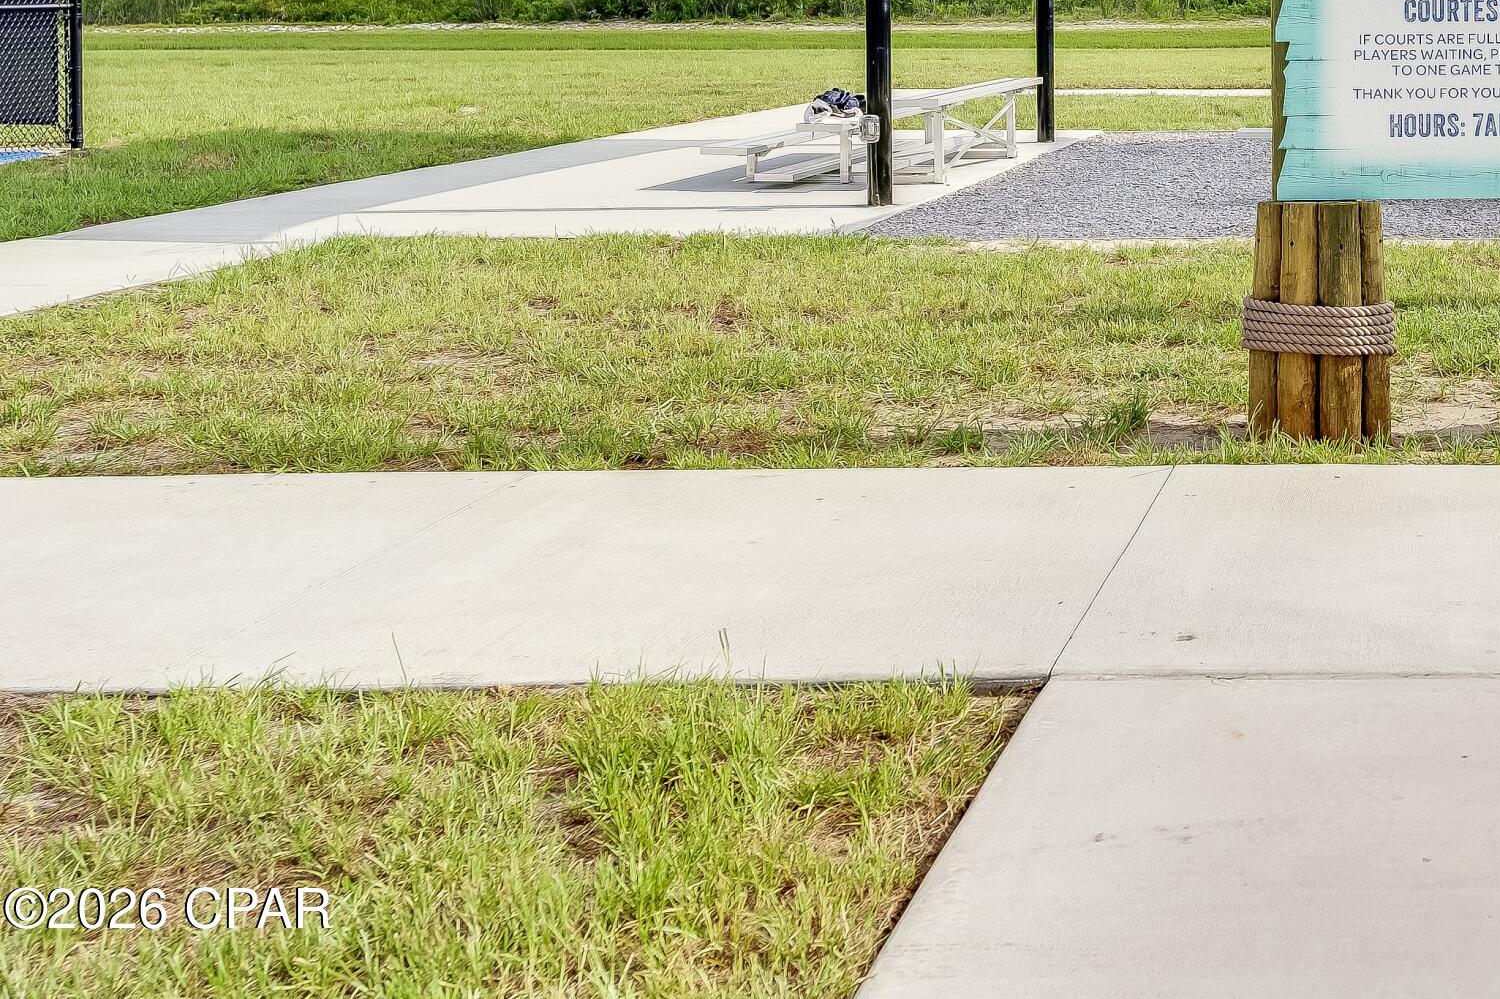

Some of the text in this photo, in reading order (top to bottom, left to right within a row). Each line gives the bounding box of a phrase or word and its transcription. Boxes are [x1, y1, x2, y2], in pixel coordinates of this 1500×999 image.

[1359, 33, 1372, 46] IF
[1374, 33, 1434, 46] COURTS
[1436, 32, 1465, 45] ARE
[1353, 48, 1418, 61] PLAYERS
[1419, 48, 1488, 62] WAITING,
[1391, 64, 1413, 77] TO
[1415, 64, 1448, 77] ONE
[1449, 63, 1492, 76] GAME
[1352, 87, 1403, 100] THANK
[1405, 87, 1437, 100] YOU
[1439, 86, 1469, 99] FOR
[1389, 112, 1466, 138] HOURS:
